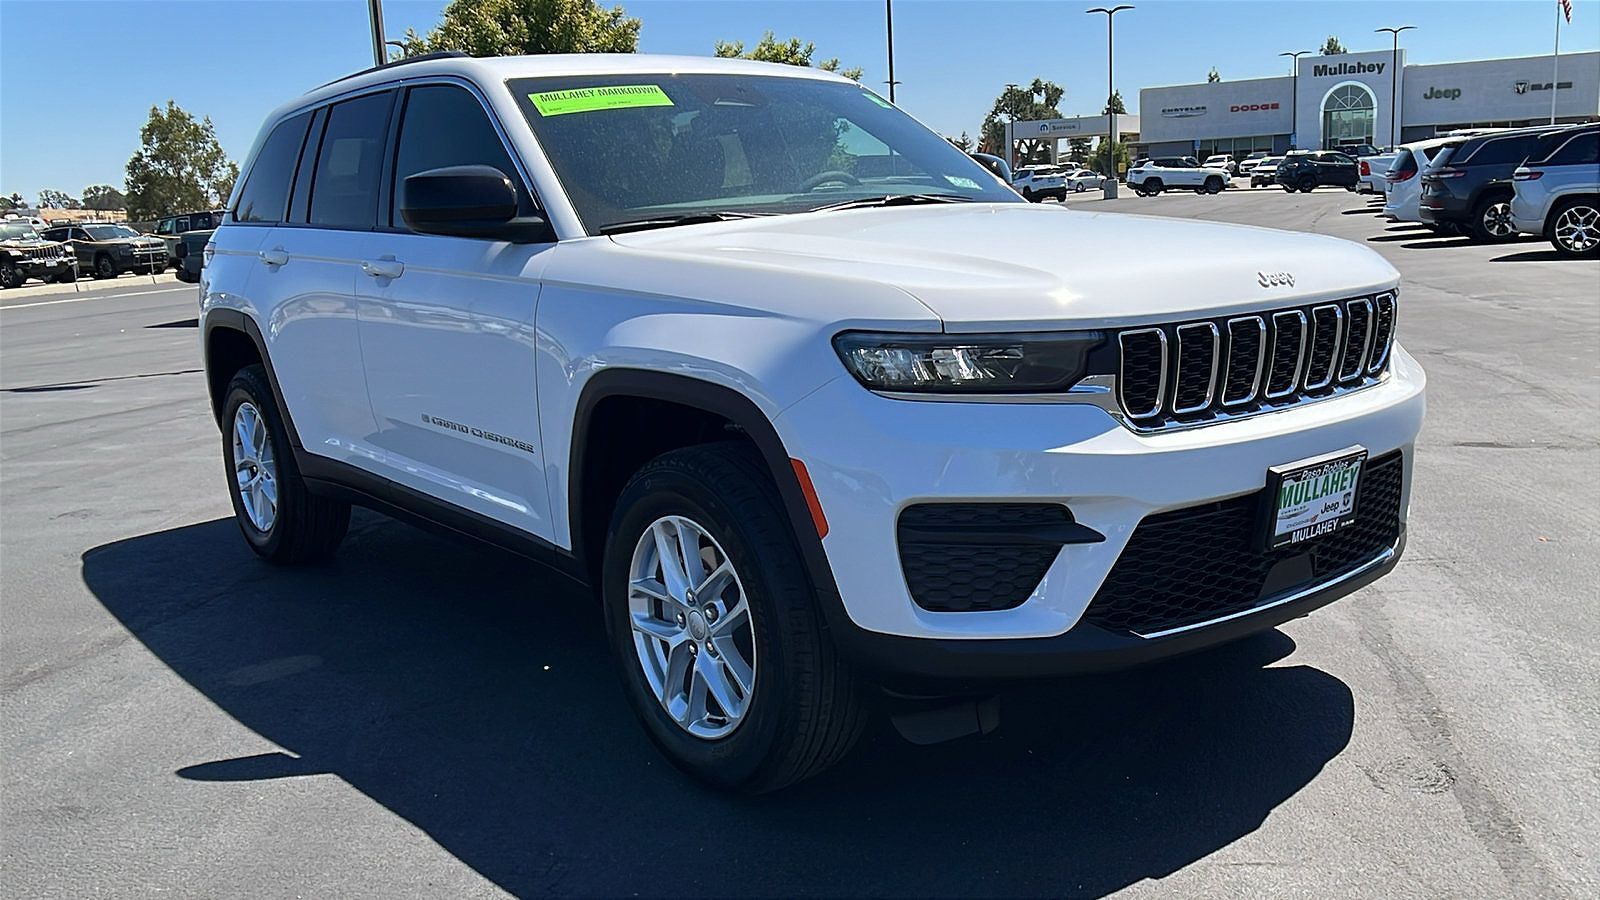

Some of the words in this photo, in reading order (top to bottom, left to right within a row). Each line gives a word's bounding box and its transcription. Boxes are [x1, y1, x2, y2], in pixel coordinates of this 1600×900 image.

[1313, 62, 1386, 77] Mullahey
[539, 89, 595, 103] MULLAHEY
[598, 87, 659, 97] MARKDOWN
[1423, 86, 1461, 100] Jeep
[1230, 103, 1279, 112] DODGE
[1257, 271, 1295, 288] Jeep
[431, 416, 469, 434] GRAND
[471, 427, 535, 454] CHEROKEE
[1301, 468, 1322, 480] Paso
[1322, 460, 1349, 476] Robles
[1280, 466, 1359, 509] MULLAHEY
[1320, 501, 1339, 514] Jeep
[1291, 518, 1339, 544] MULLAHEY
